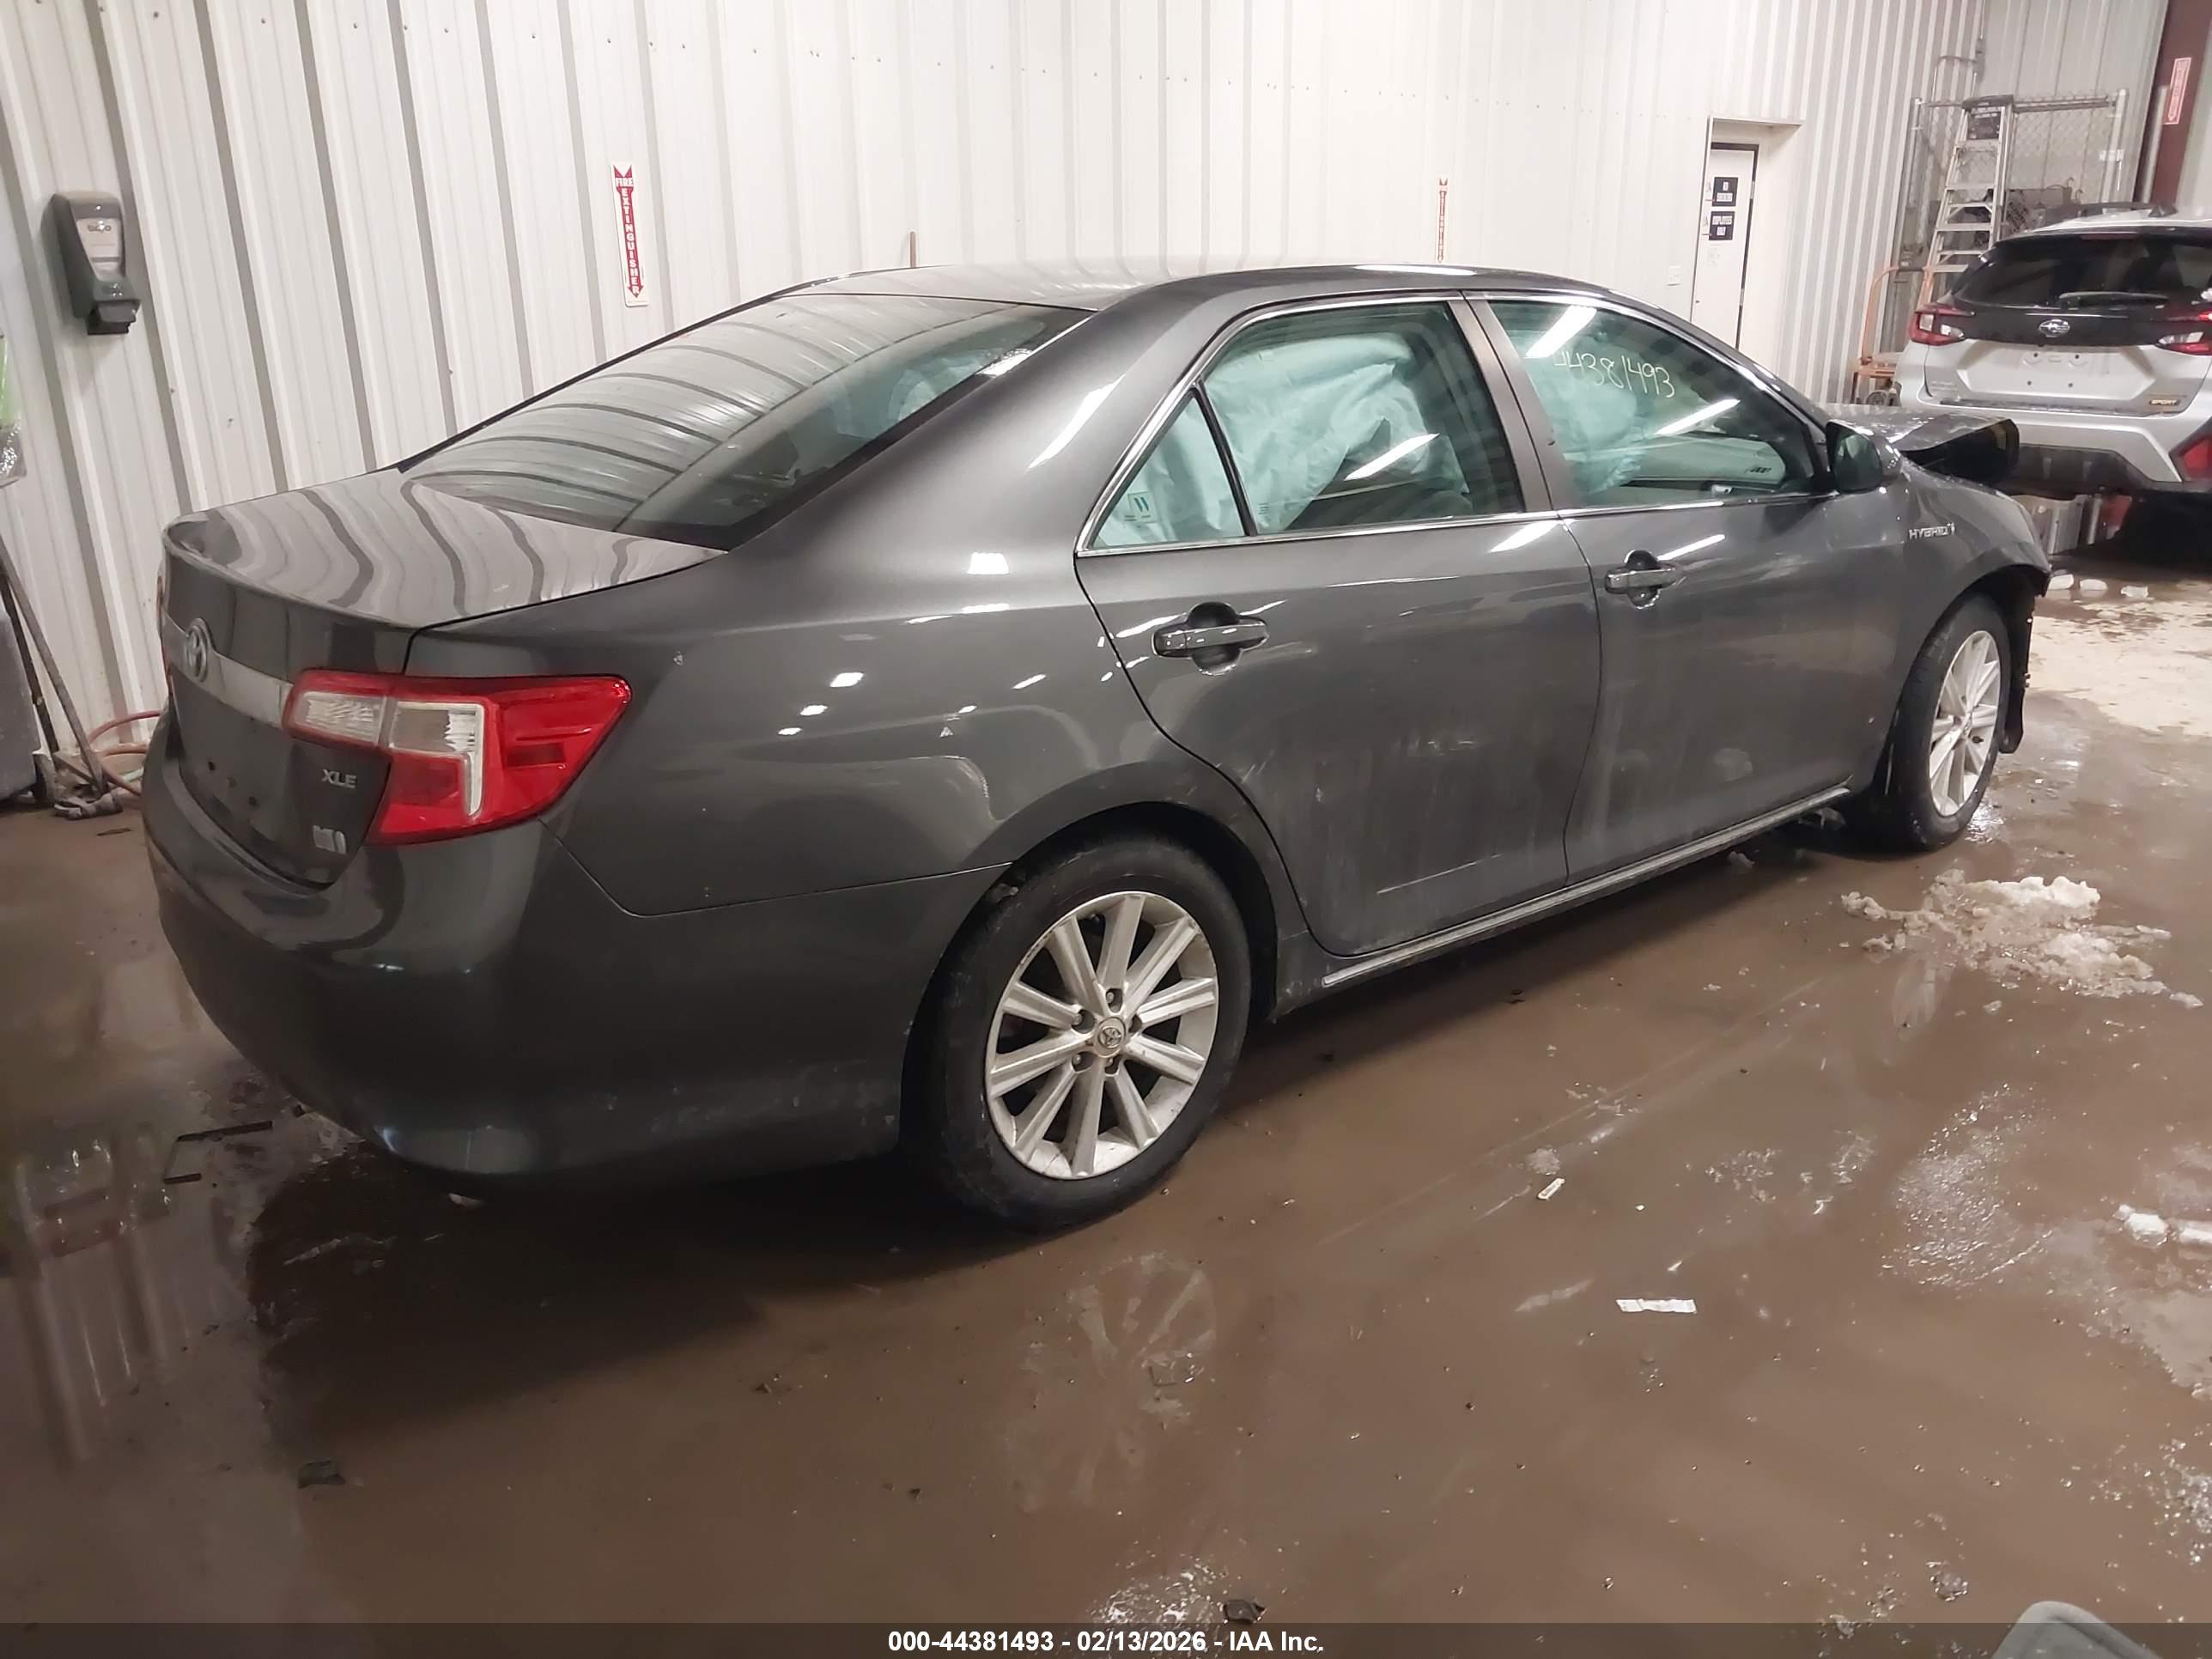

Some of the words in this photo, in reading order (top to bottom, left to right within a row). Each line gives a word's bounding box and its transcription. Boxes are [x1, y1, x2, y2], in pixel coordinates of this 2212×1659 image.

[616, 177, 635, 187] FIRE
[621, 187, 640, 295] EXTINGUISHER
[1555, 350, 1675, 398] 44381493
[1908, 526, 1949, 539] HYBRID
[321, 769, 357, 788] XLE
